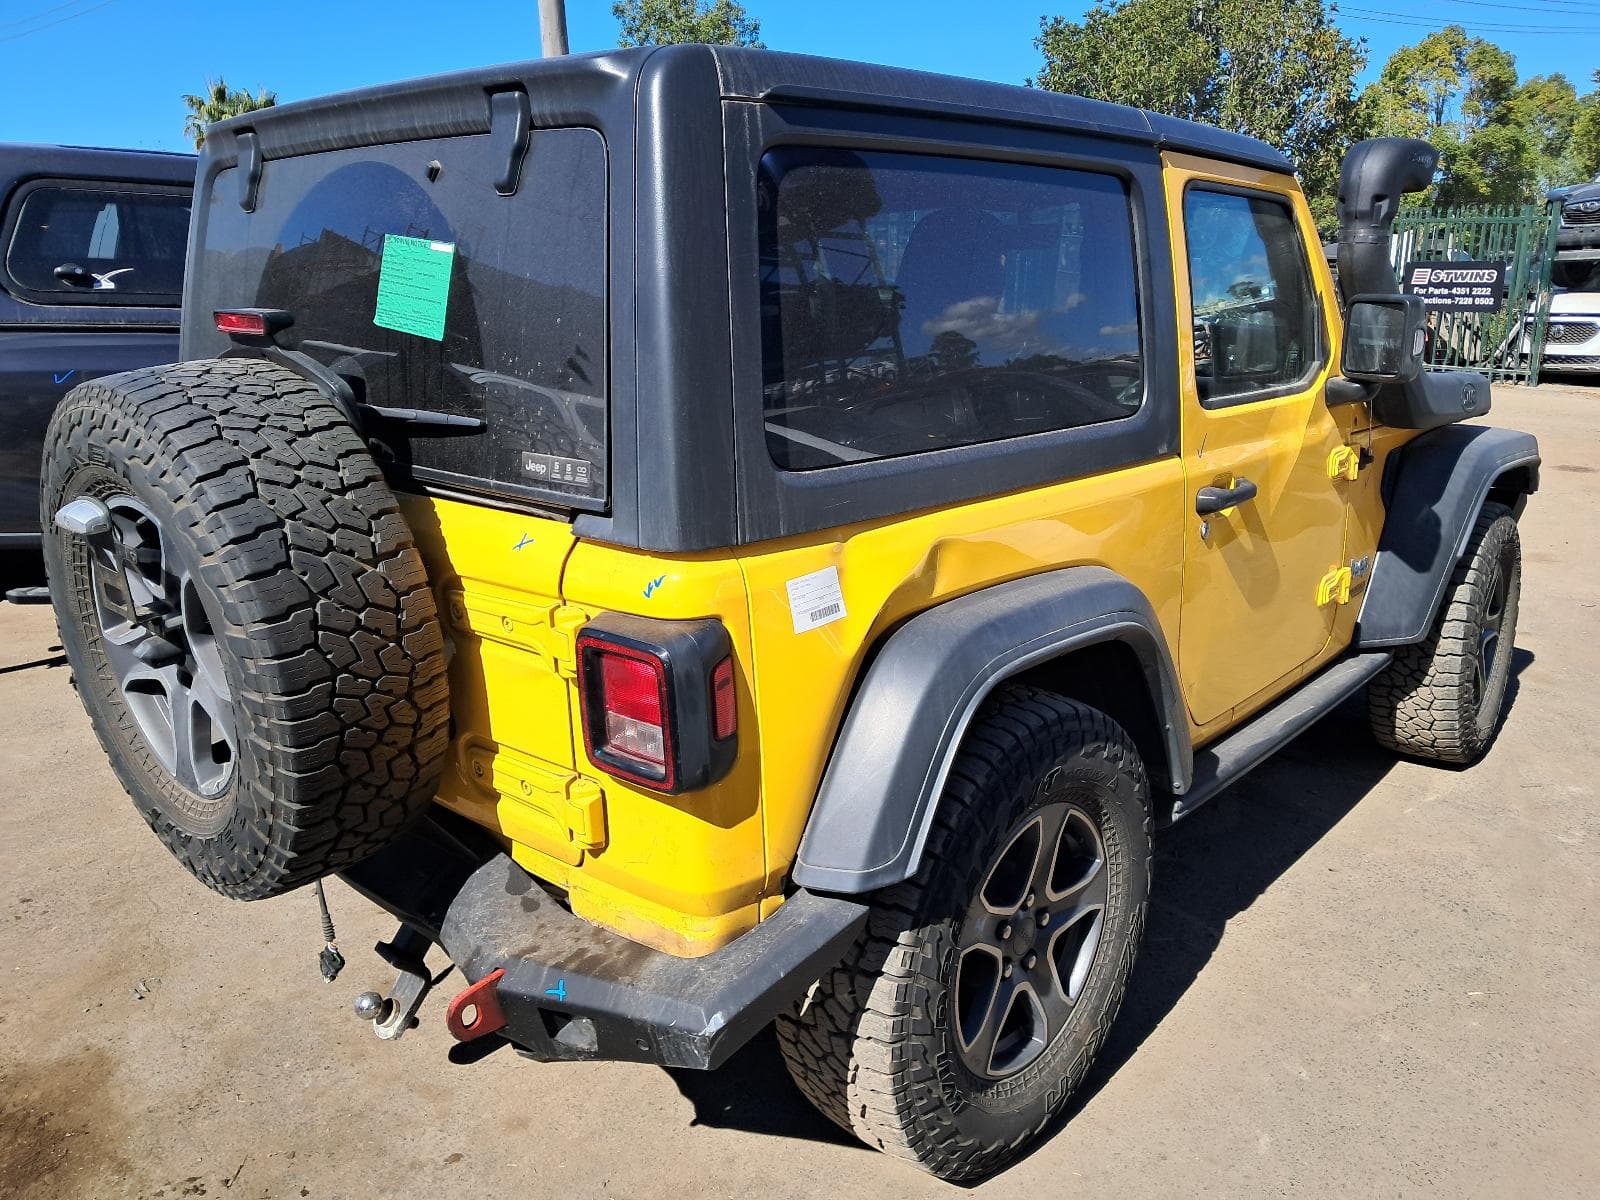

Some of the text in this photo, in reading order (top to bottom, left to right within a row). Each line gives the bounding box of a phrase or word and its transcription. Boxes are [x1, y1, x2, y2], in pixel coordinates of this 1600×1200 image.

[1413, 287, 1491, 295] For Parts-4351 2222
[1474, 297, 1495, 305] 0502
[525, 459, 546, 474] Jeep
